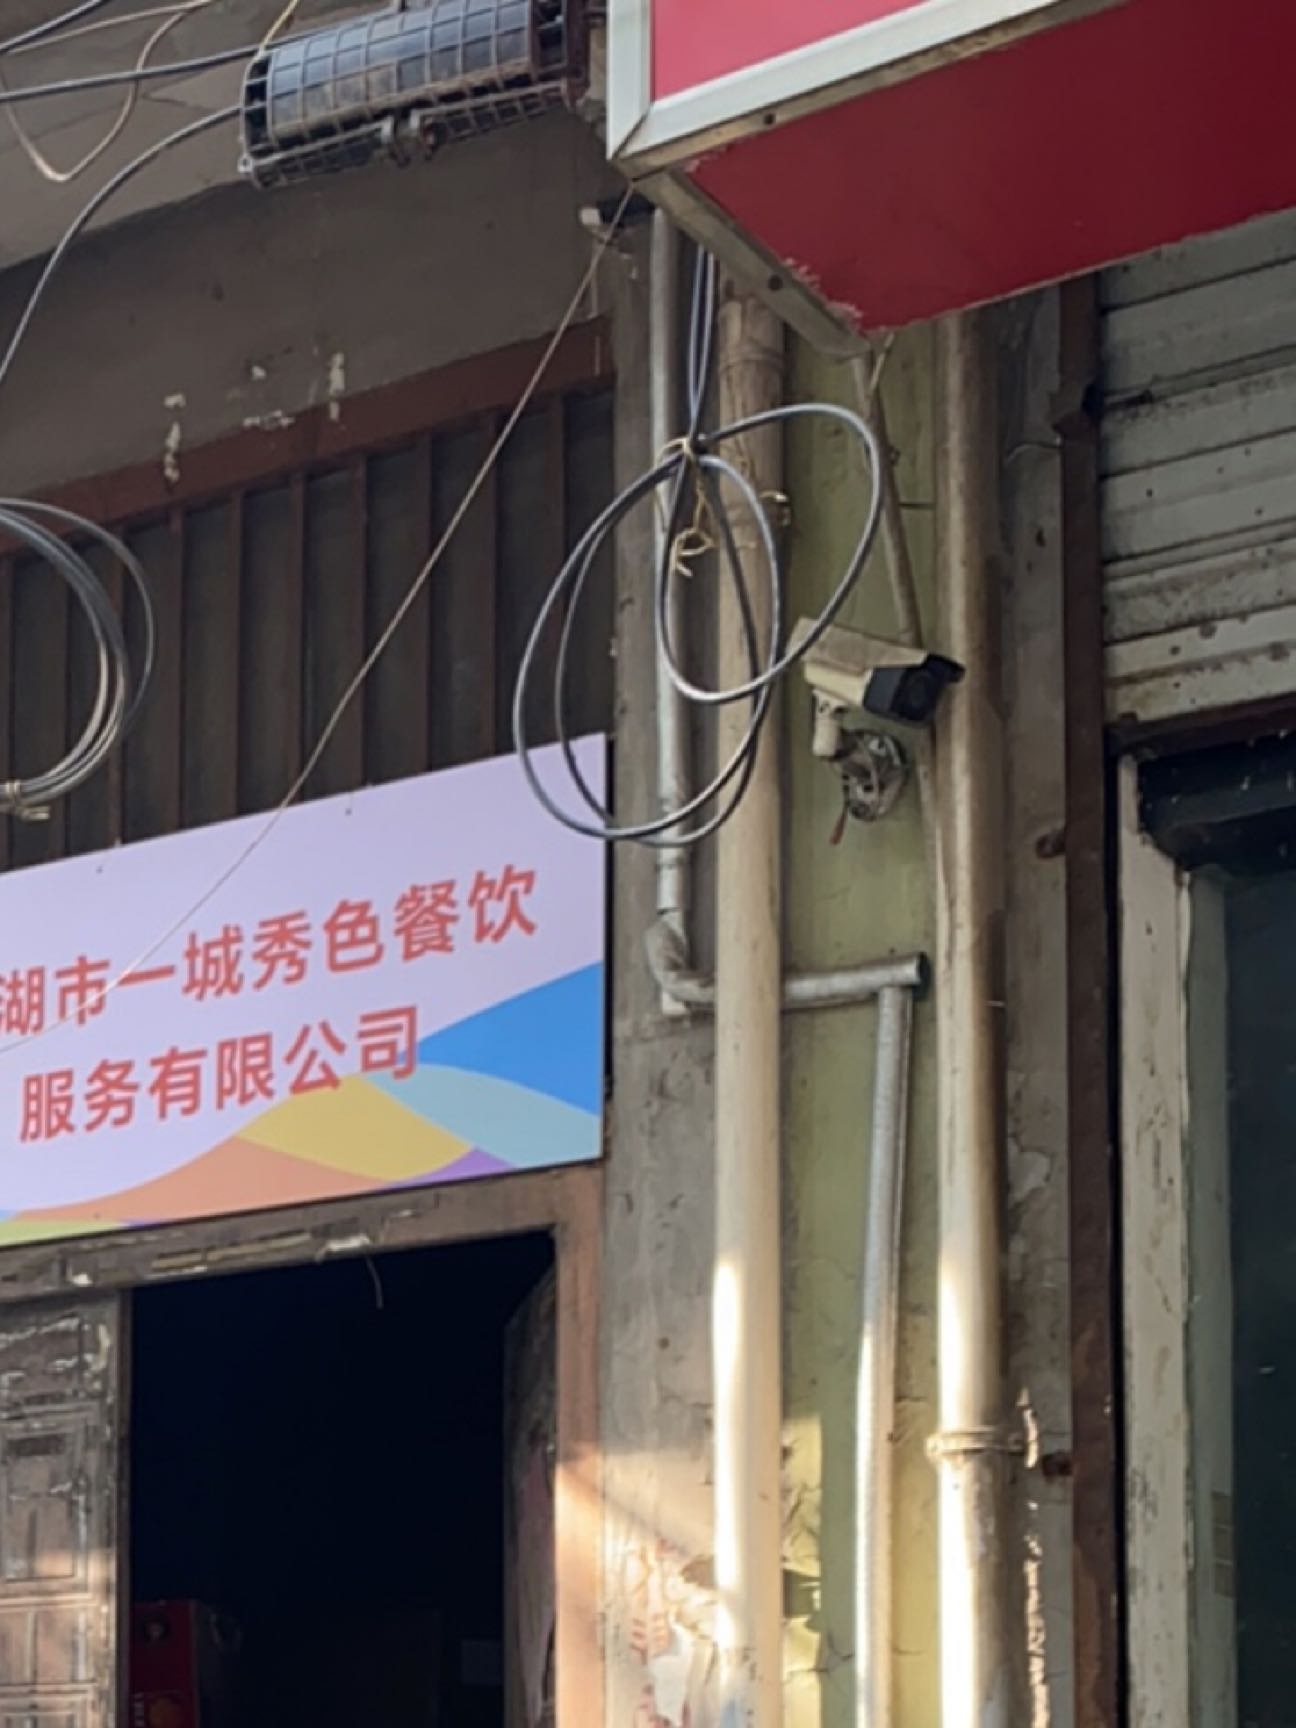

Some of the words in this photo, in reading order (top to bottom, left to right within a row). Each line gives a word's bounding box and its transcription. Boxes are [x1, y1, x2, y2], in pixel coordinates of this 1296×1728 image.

[18, 1005, 420, 1143] 服务有限公司
